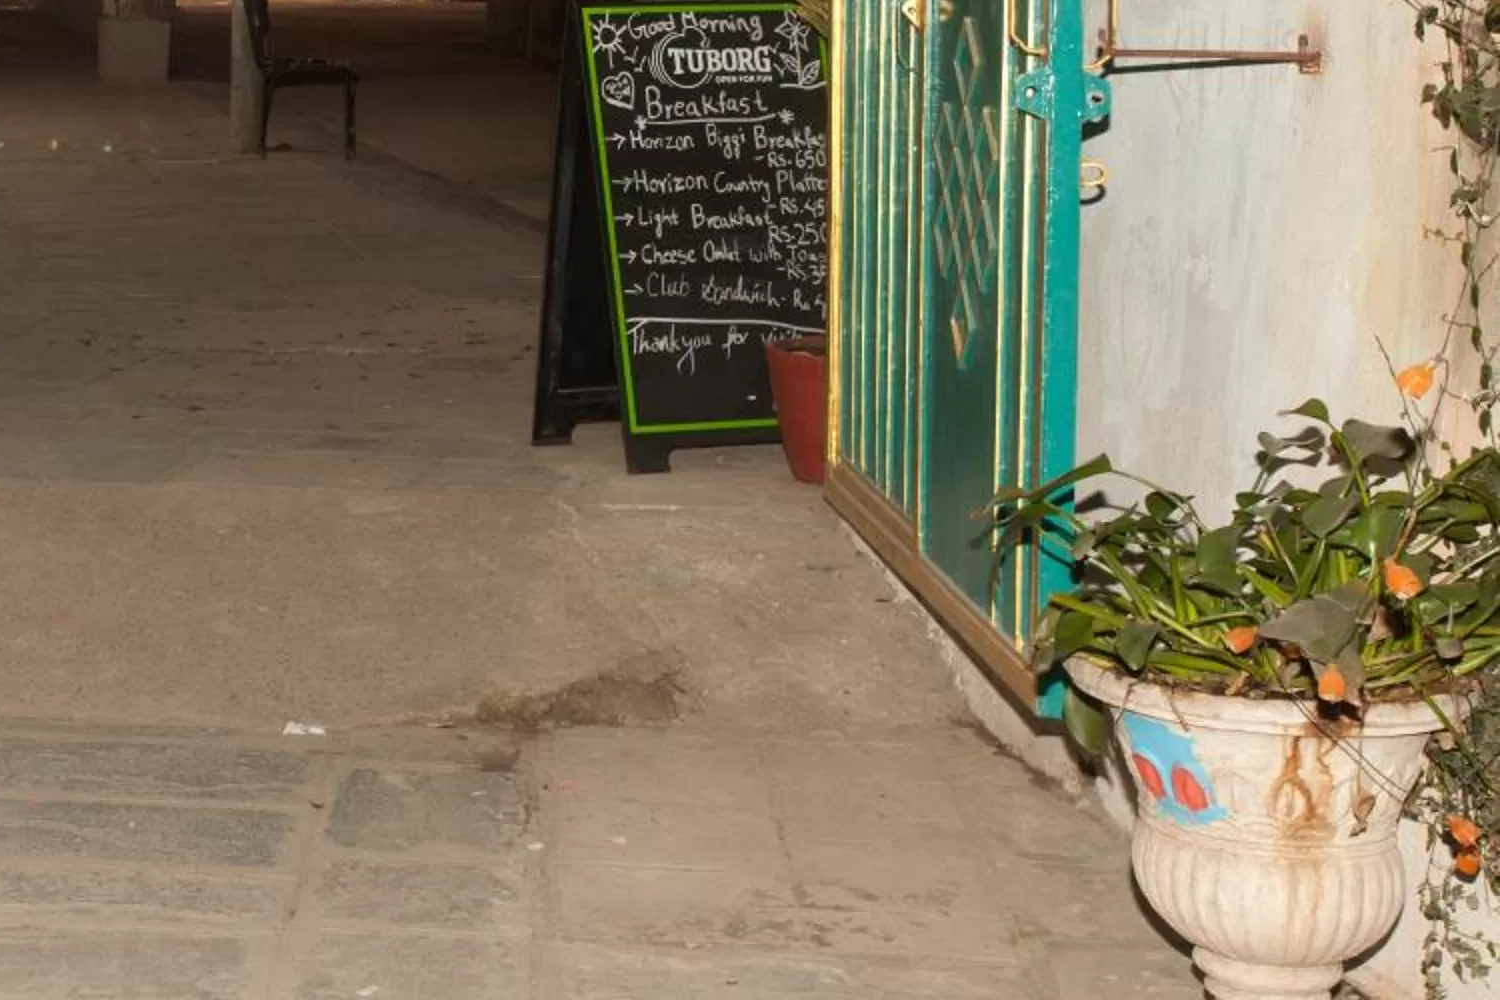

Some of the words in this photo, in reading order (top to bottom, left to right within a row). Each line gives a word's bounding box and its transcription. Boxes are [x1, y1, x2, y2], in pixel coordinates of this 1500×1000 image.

[628, 11, 676, 40] Good
[681, 11, 764, 42] Morning
[667, 45, 772, 75] TUBORG
[644, 85, 768, 119] Breakfast
[753, 125, 827, 150] Breakfas
[632, 168, 709, 194] Horizon
[776, 169, 828, 194] Platte
[637, 204, 680, 239] Light
[646, 271, 691, 298] Club
[721, 324, 749, 360] for
